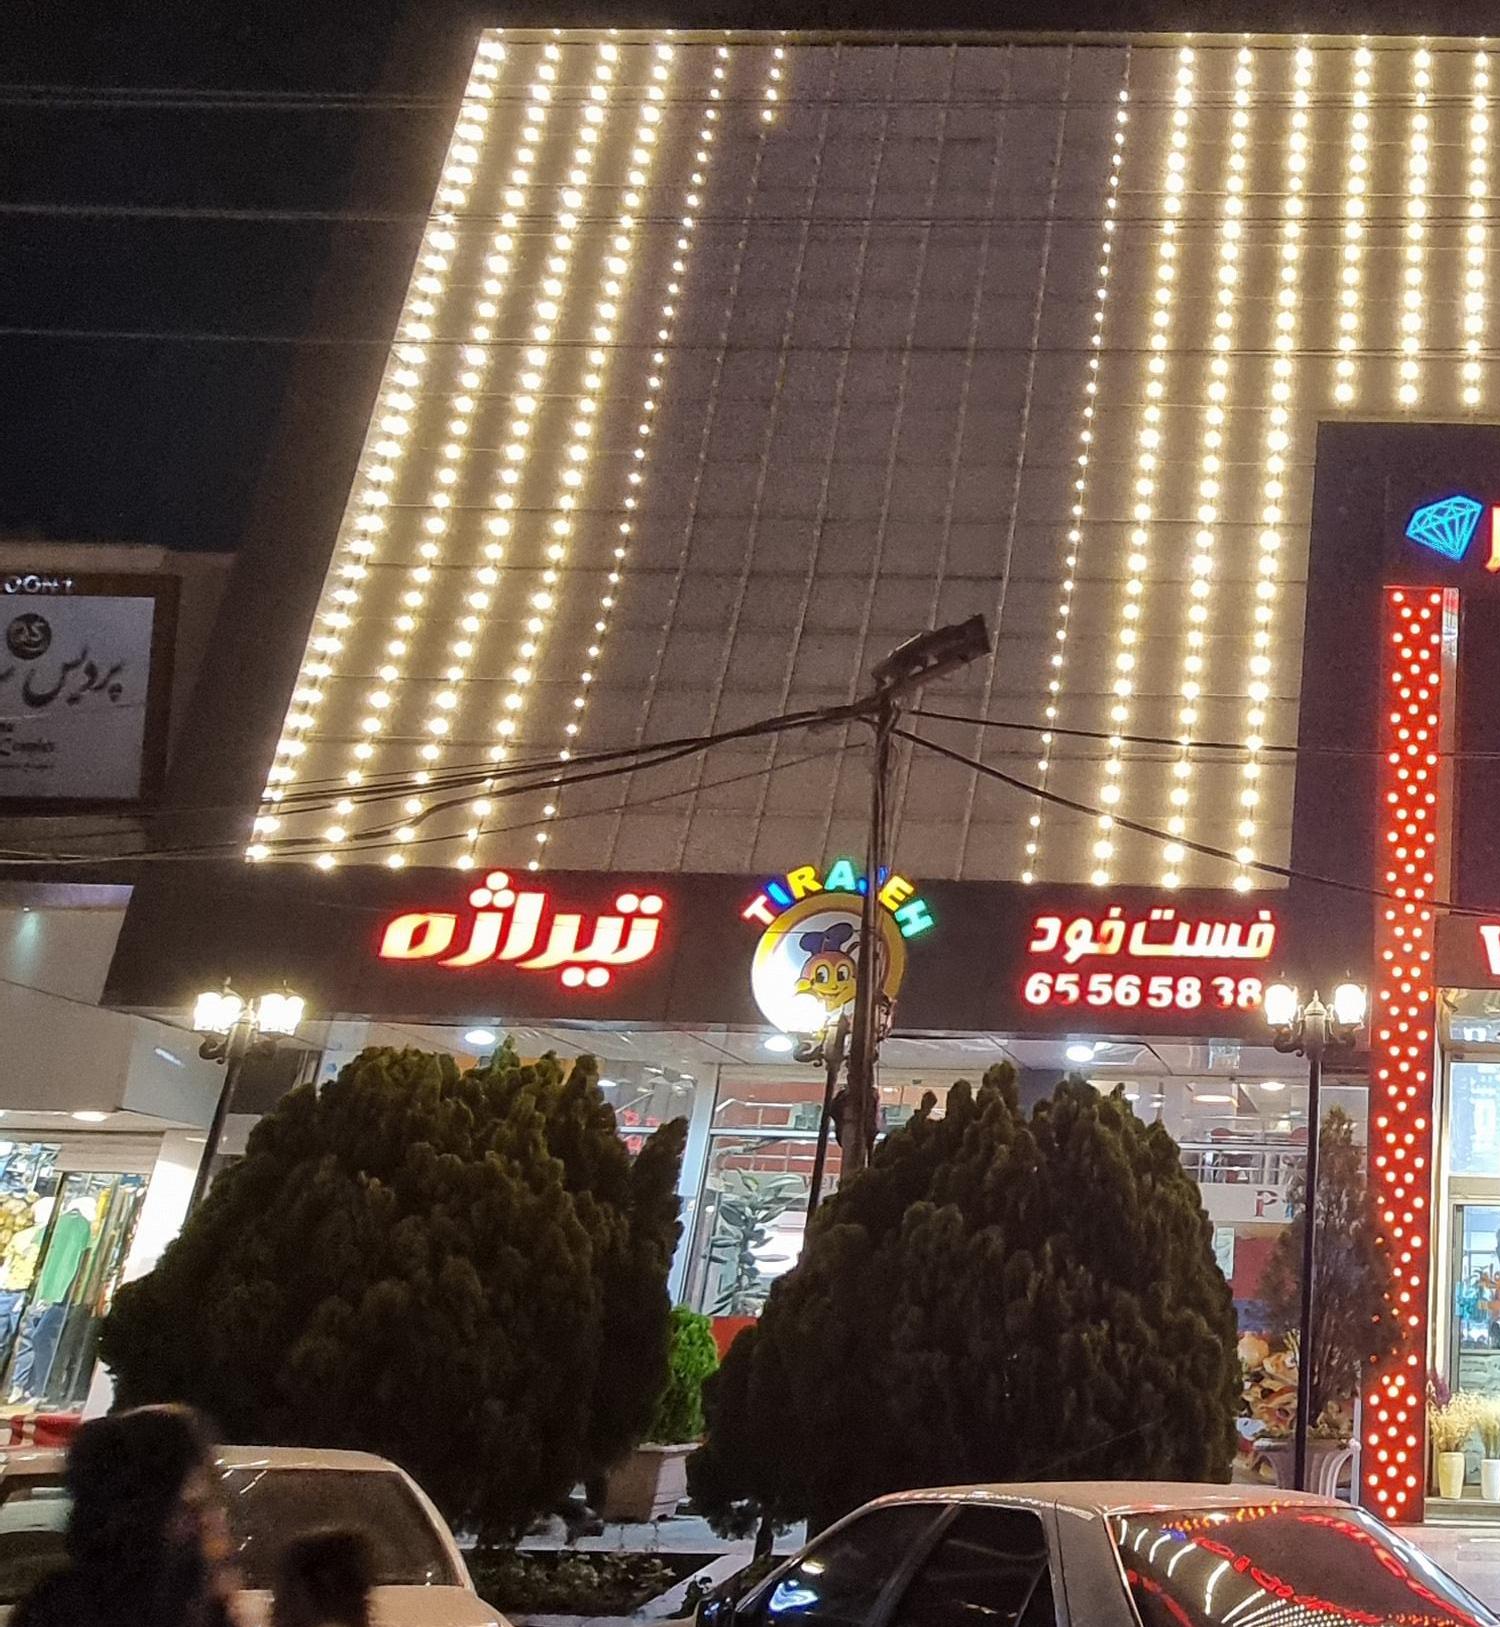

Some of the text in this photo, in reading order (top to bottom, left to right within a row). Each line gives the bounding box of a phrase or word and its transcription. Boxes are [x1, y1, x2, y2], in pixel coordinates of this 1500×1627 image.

[380, 871, 664, 988] تیراژه
[1029, 906, 1277, 964] فست فود
